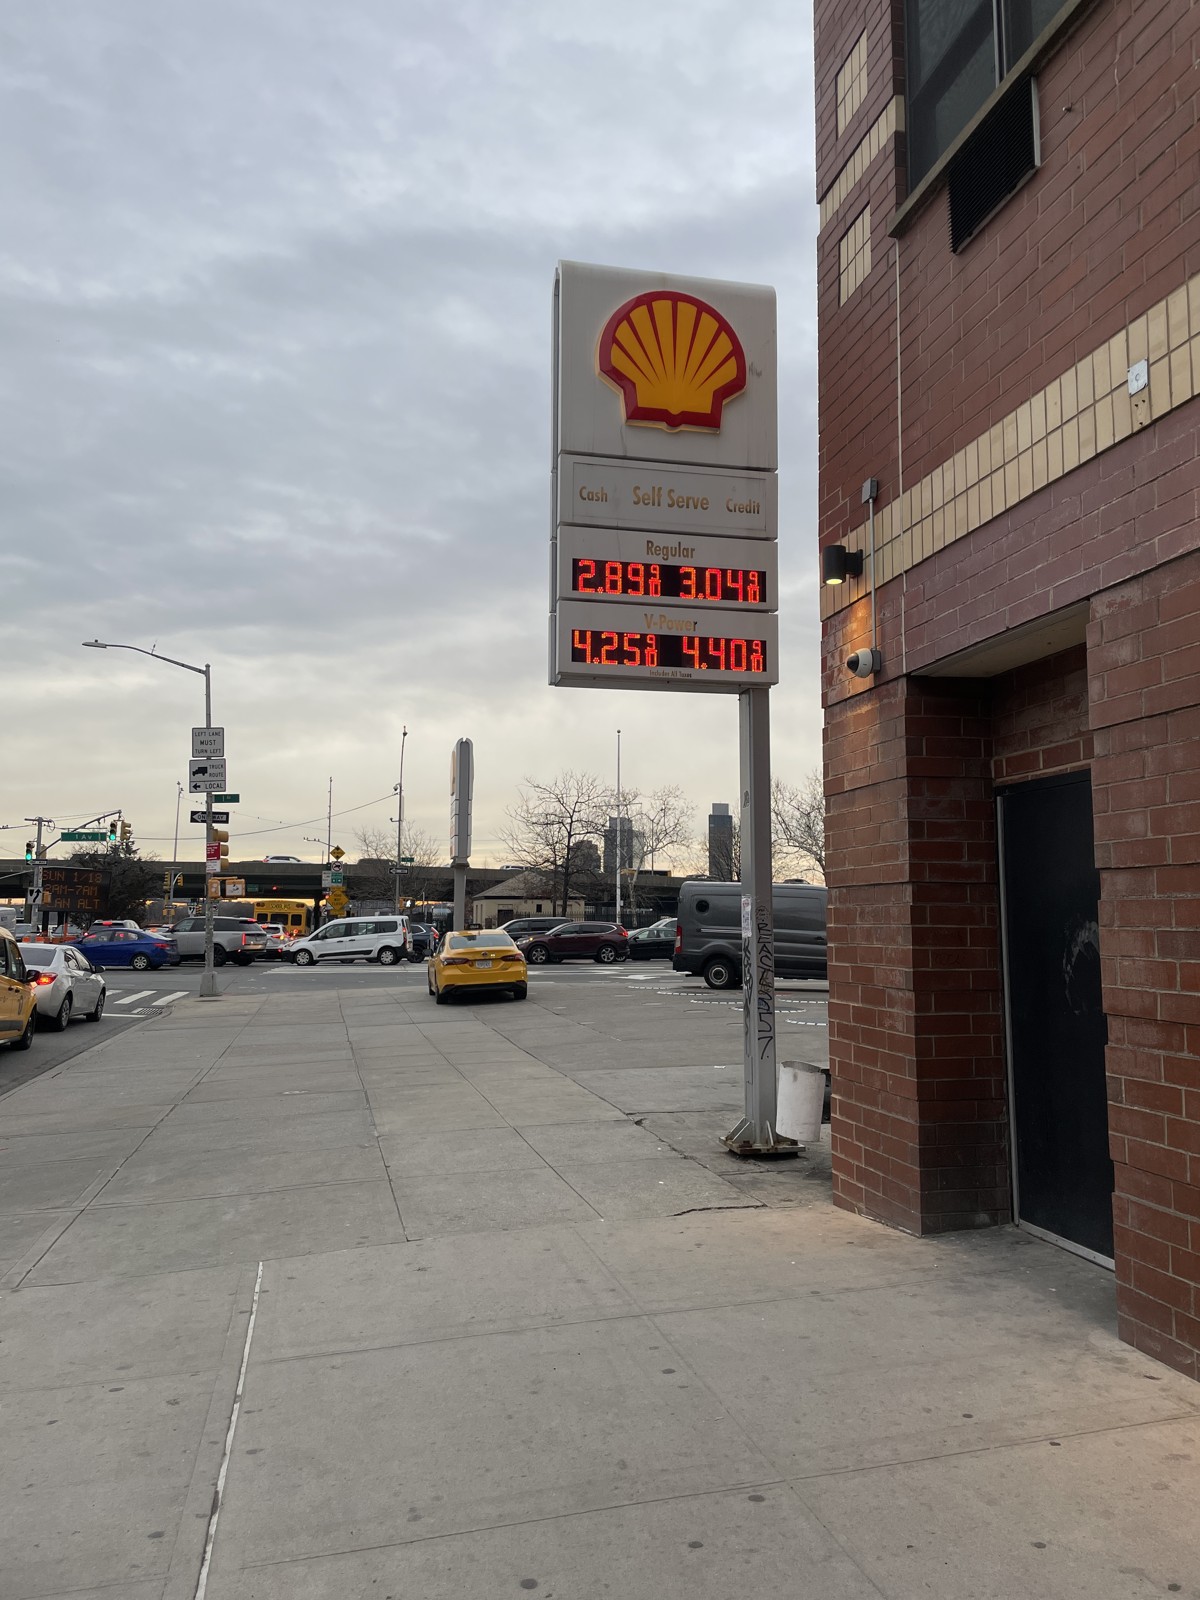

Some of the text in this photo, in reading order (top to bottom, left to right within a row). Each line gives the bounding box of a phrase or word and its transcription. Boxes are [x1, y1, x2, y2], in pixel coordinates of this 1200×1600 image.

[579, 485, 608, 503] Cash
[632, 485, 710, 511] Self Serve
[726, 498, 761, 515] Credit
[646, 540, 696, 561] Regular
[643, 613, 698, 632] V-Power
[205, 782, 224, 790] LOCAL
[42, 870, 103, 883] SUN 1/18
[78, 898, 100, 909] ALT
